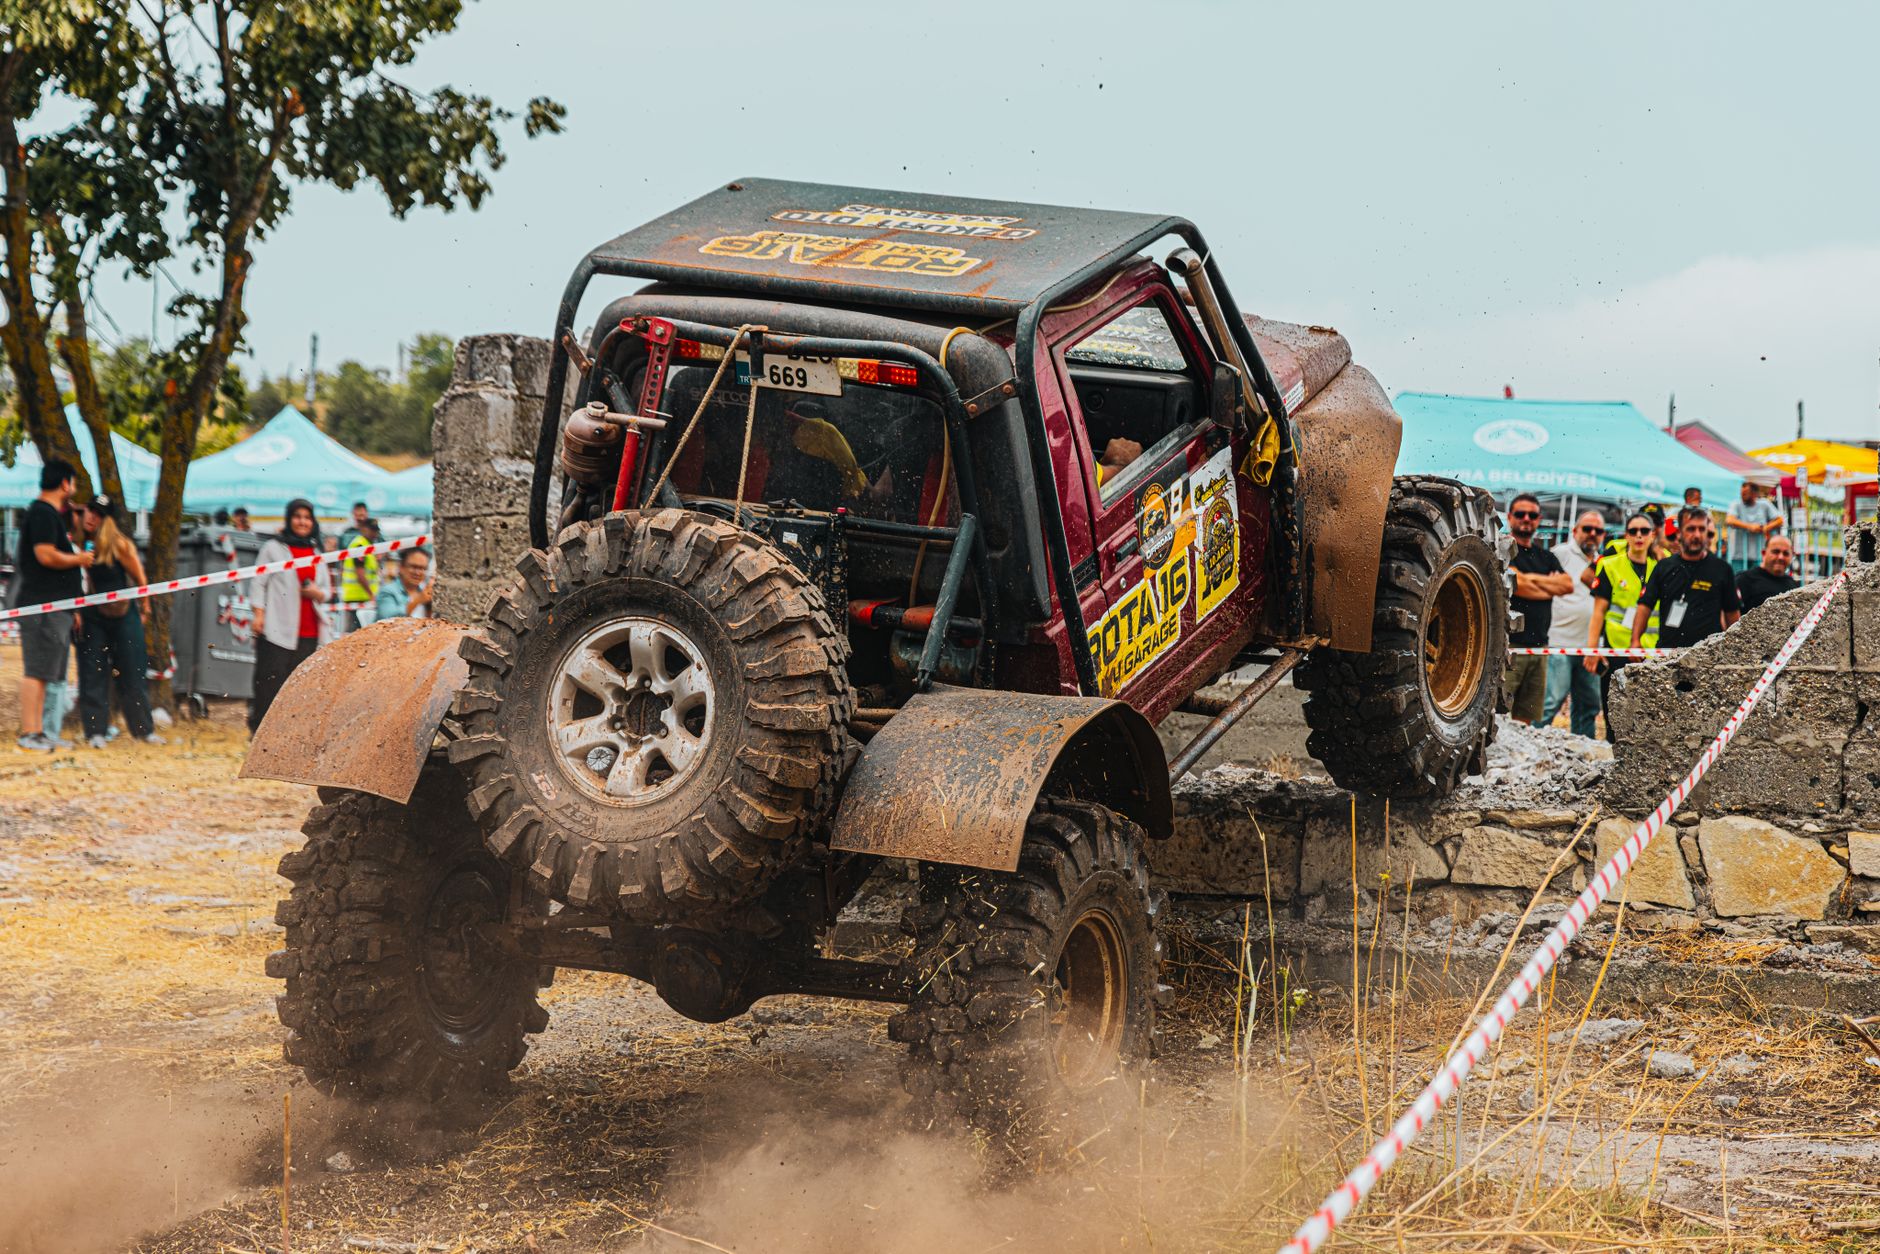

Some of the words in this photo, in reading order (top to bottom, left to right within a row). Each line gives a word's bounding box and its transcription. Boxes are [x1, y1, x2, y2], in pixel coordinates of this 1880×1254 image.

[783, 212, 861, 225] OTO
[768, 364, 808, 388] 669
[1487, 469, 1598, 488] BELEDİYESİ
[1124, 613, 1177, 675] GARAGE
